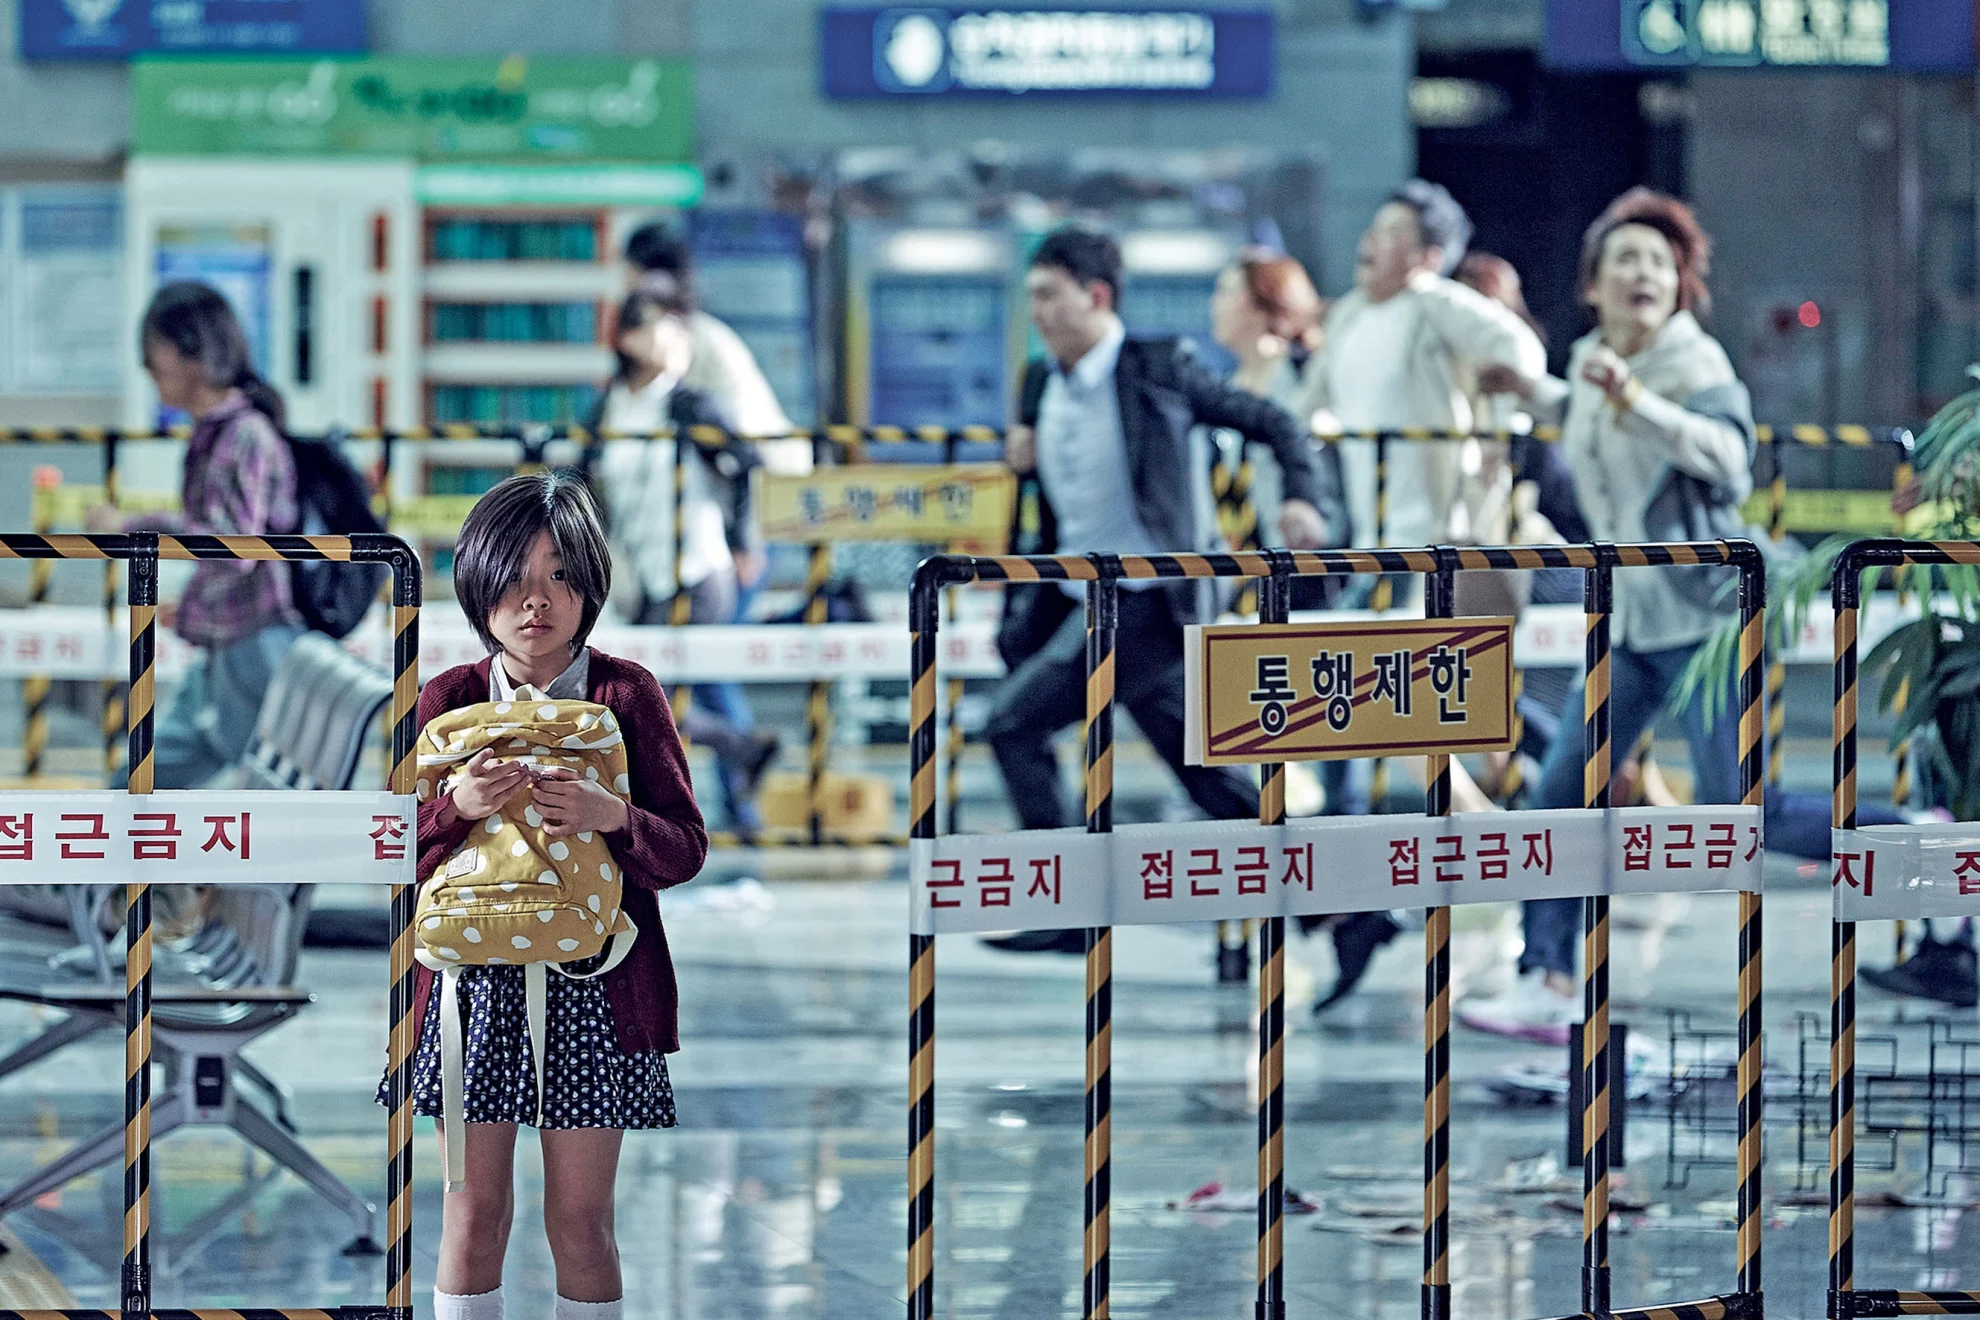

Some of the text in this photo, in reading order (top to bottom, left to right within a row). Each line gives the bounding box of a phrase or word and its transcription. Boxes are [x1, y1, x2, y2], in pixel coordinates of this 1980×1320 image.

[1249, 645, 1471, 736] 통행제한
[0, 812, 250, 860] 접근금지
[926, 854, 1061, 908] 근금지
[1140, 842, 1314, 900] 접근금지
[1387, 829, 1553, 886] 접근금지
